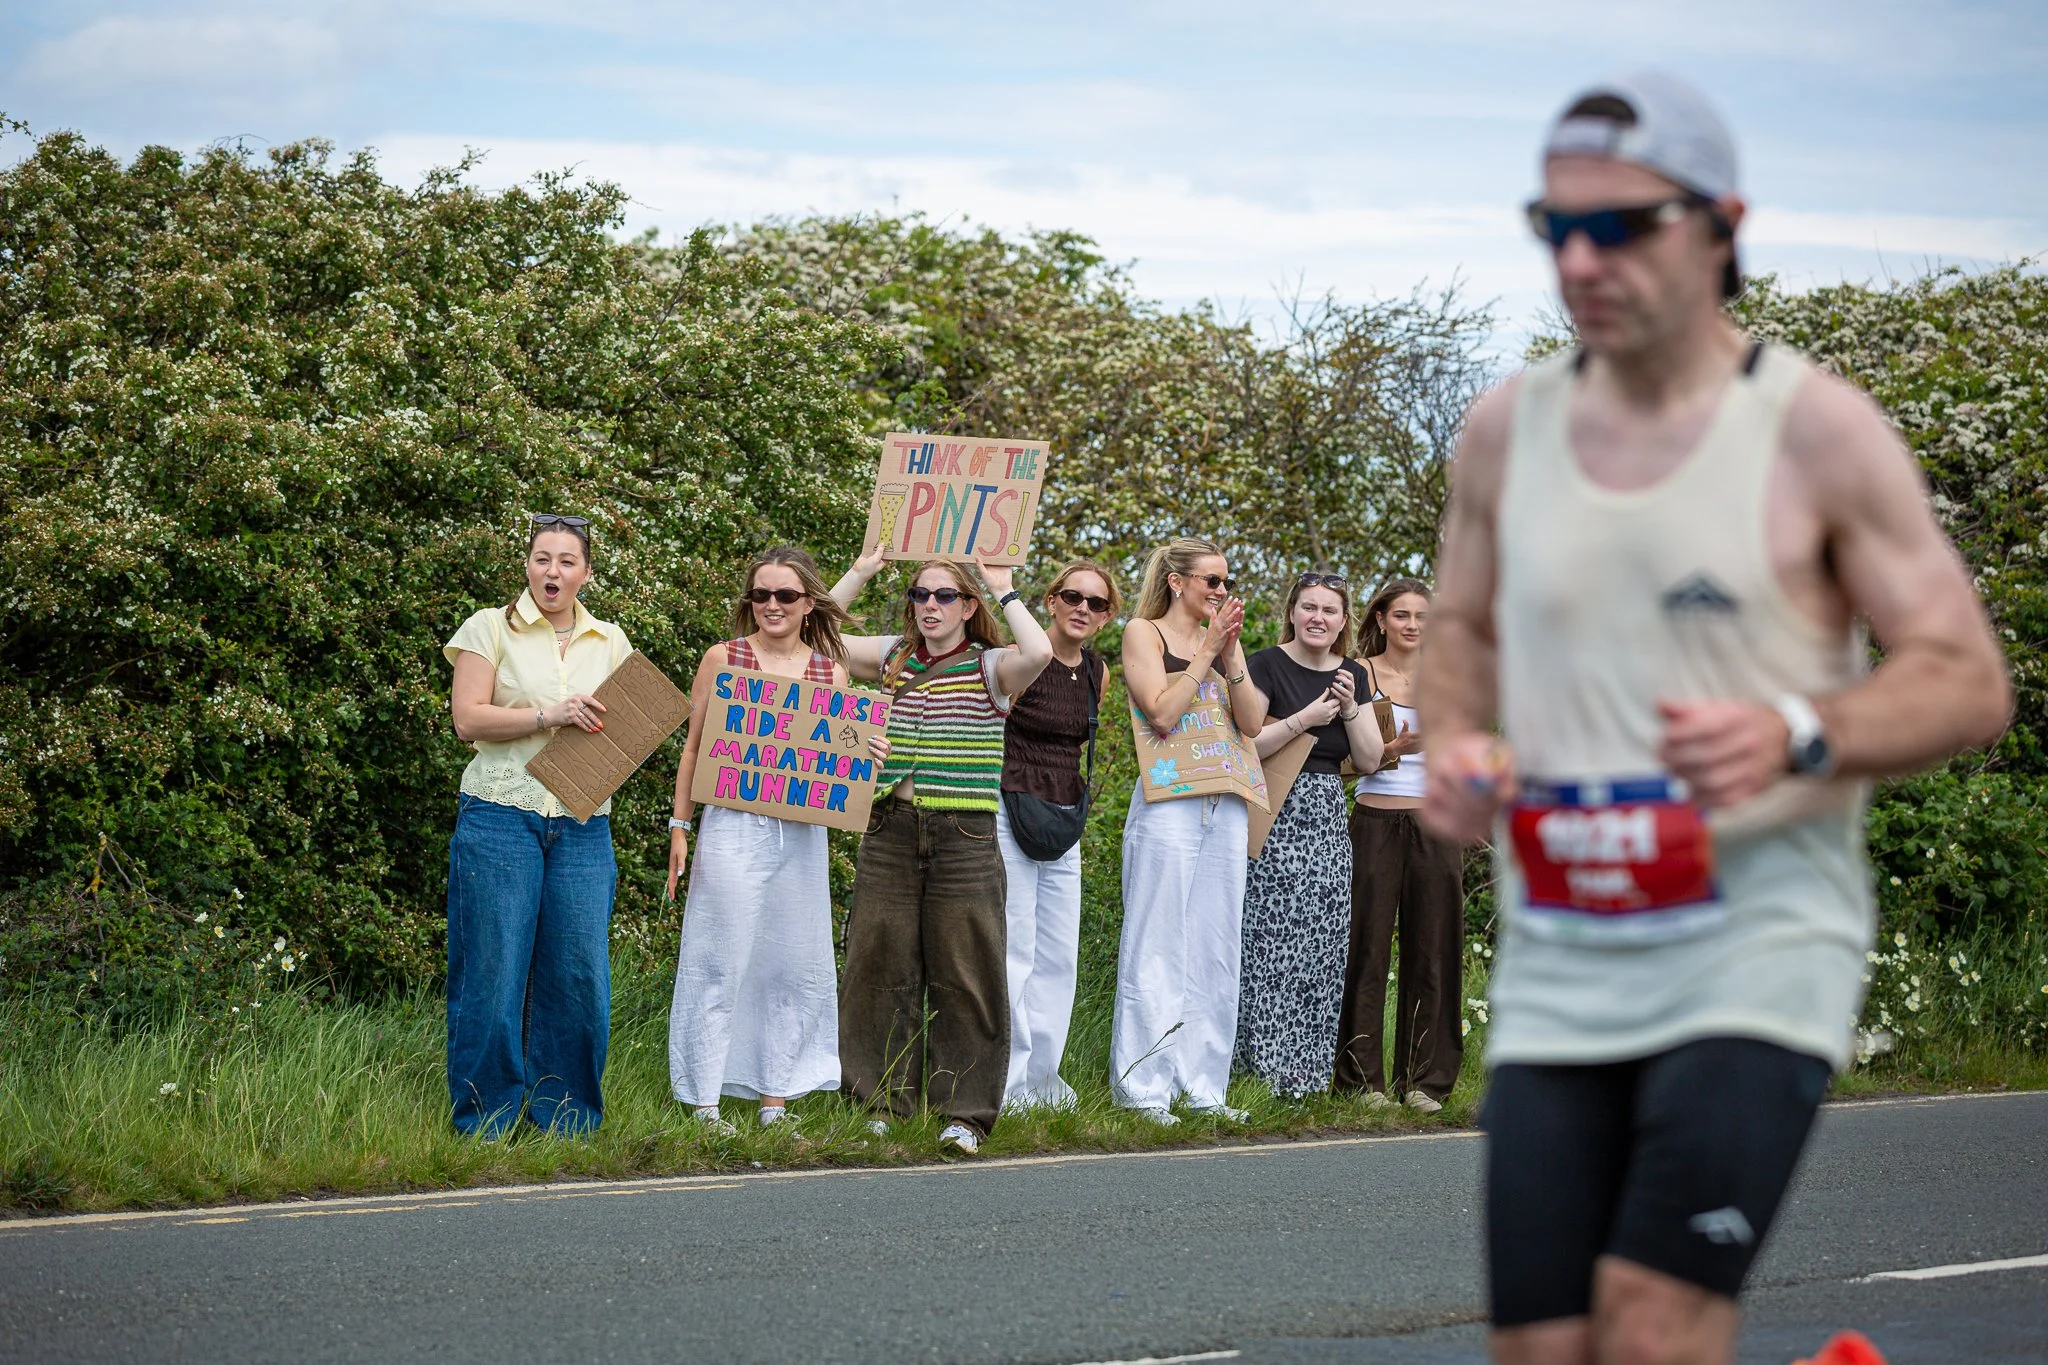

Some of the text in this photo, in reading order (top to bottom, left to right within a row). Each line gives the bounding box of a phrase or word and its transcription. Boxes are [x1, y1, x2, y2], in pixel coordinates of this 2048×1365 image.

[894, 441, 1040, 480] THINK OF THE
[901, 481, 1030, 556] PINTS!
[716, 672, 889, 727] SAVE A HORSE
[725, 704, 831, 743] RIDE A
[709, 738, 872, 781] MARATHON
[714, 765, 849, 812] RUNNER
